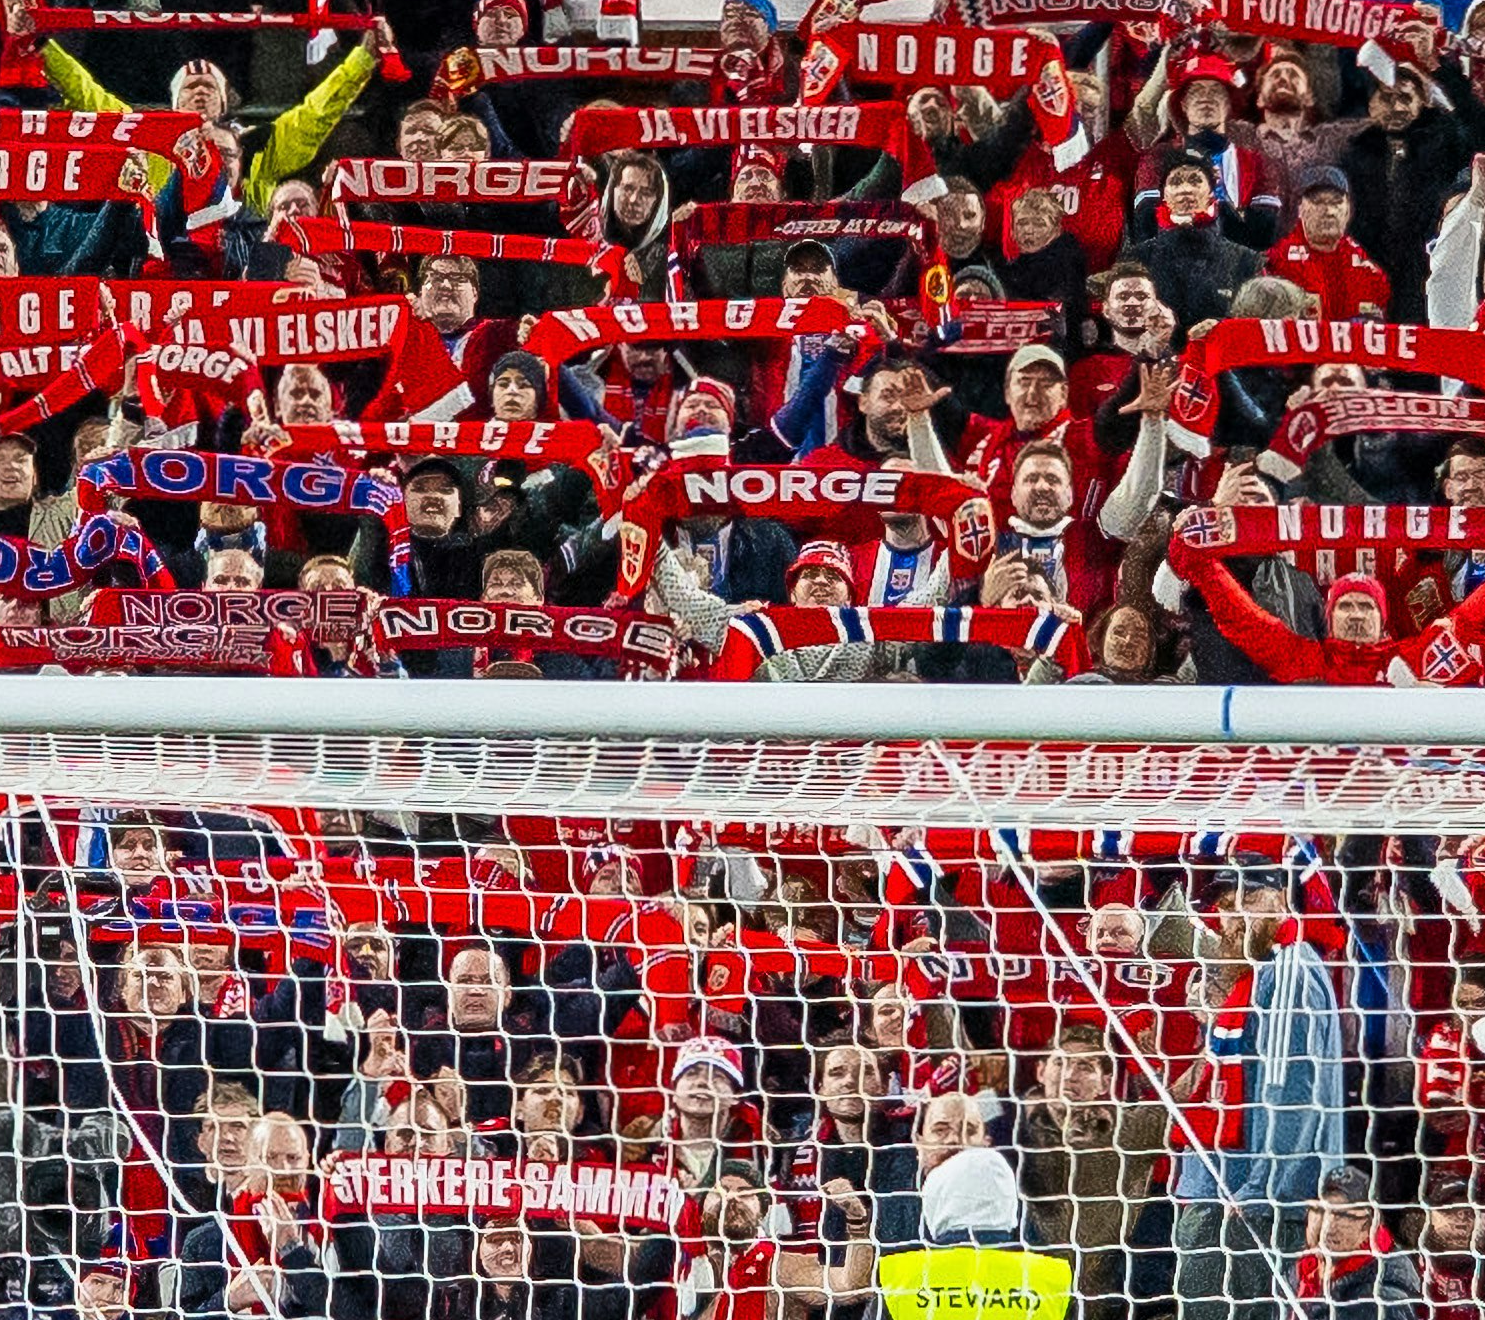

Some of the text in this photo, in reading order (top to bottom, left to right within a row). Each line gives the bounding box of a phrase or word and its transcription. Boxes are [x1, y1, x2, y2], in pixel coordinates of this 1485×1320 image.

[858, 34, 1029, 79] NORGE
[638, 106, 861, 145] JA, VI ELSKER
[333, 161, 568, 198] NORGE
[277, 302, 402, 356] ELSKER
[554, 298, 814, 352] NORGE
[1263, 319, 1418, 359] NORGE
[0, 348, 50, 379] ALT
[332, 419, 556, 456] NORGE
[684, 470, 904, 507] NORGE
[1278, 504, 1469, 543] NORGE
[122, 591, 362, 629] NORGE
[382, 601, 674, 657] NORGE
[916, 955, 1173, 989] NORG
[333, 1157, 513, 1208] STERKERE
[916, 1286, 1041, 1311] STEWARD
